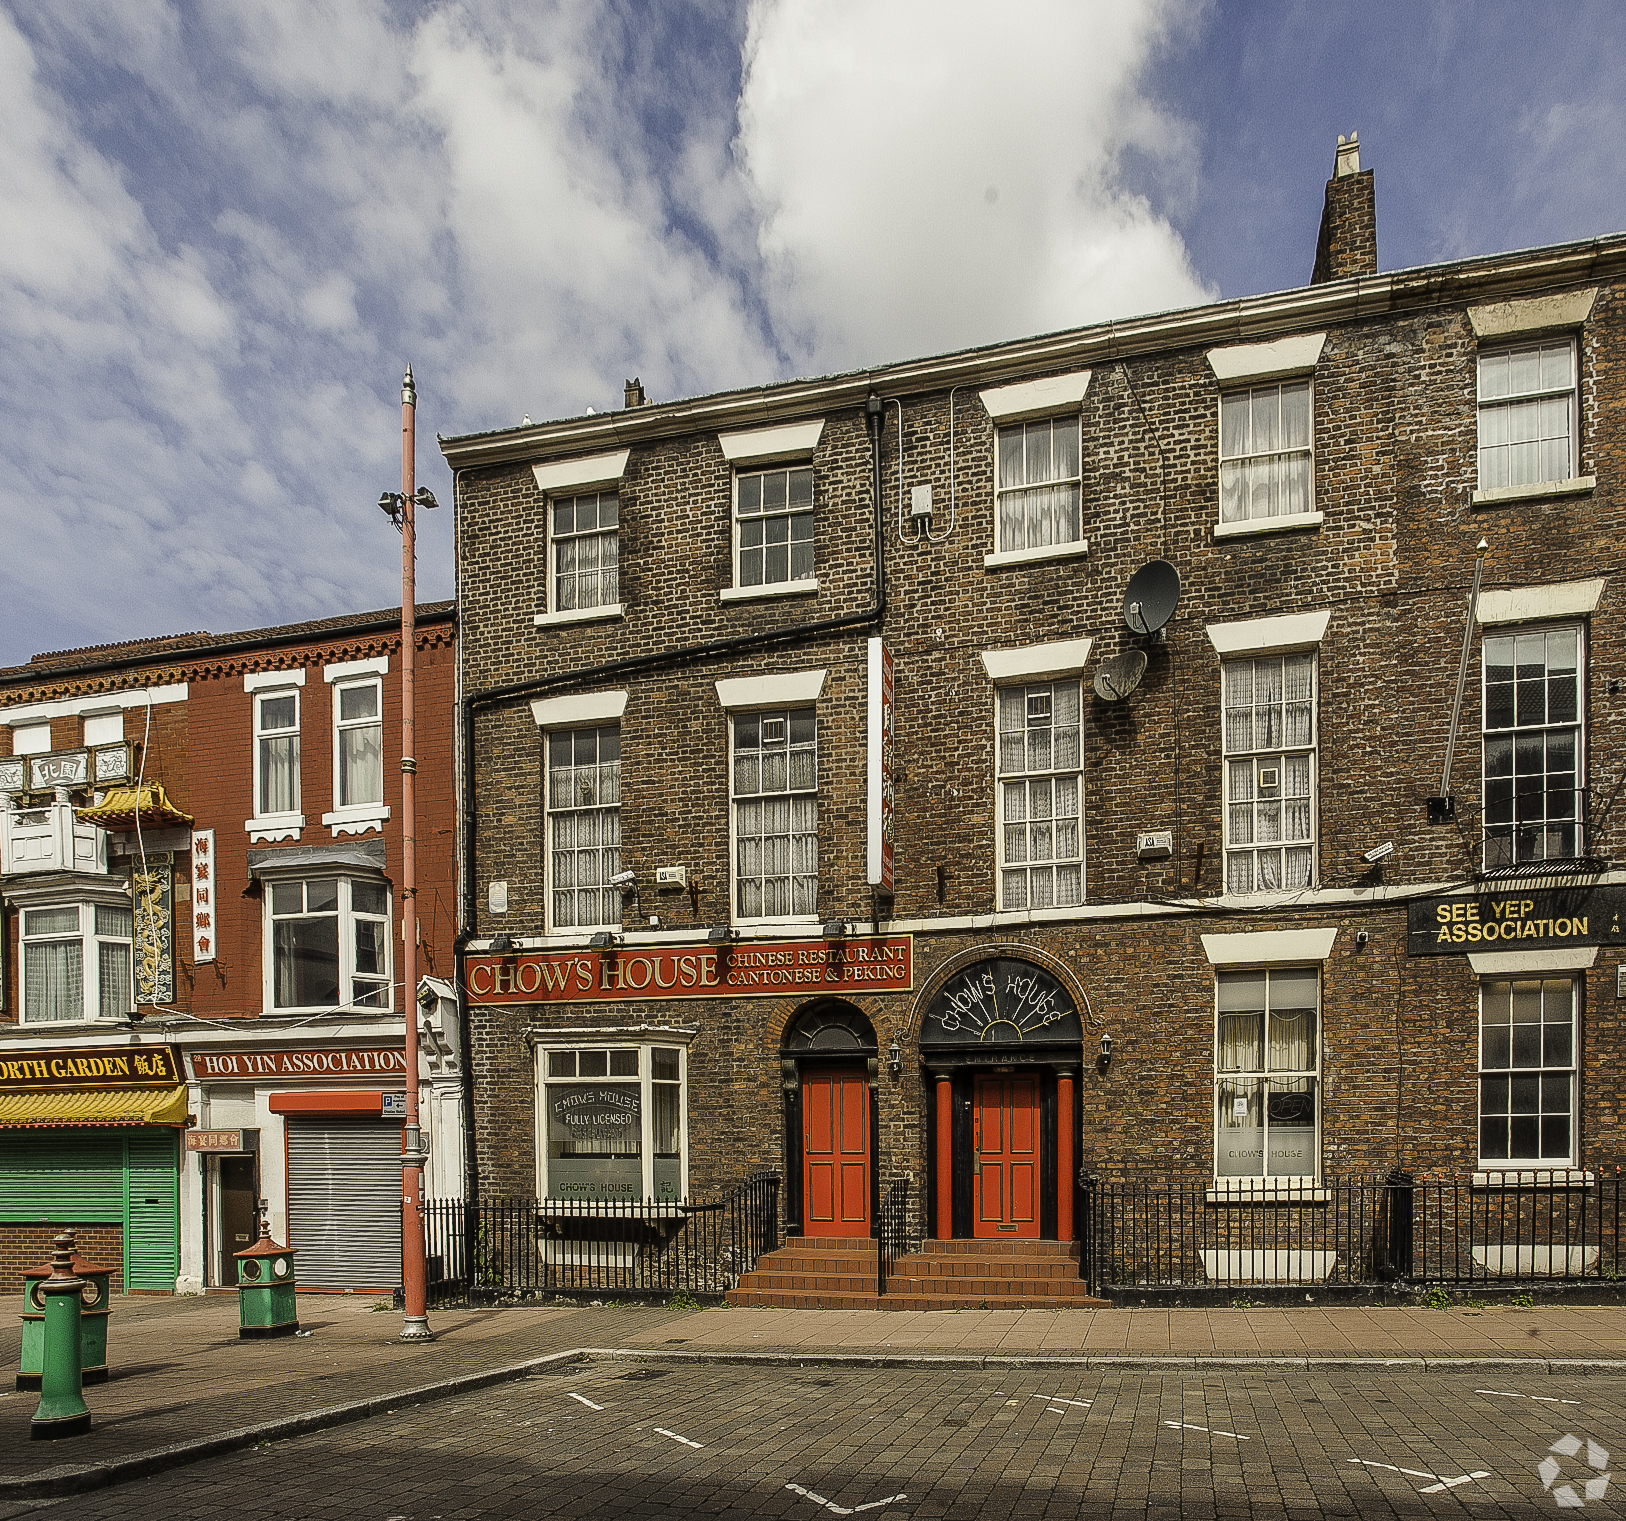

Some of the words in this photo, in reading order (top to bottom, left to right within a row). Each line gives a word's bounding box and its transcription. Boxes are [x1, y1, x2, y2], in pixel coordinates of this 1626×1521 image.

[1437, 903, 1480, 923] SEE
[1491, 900, 1534, 919] YEP
[1437, 917, 1588, 943] ASSOCIATION
[726, 952, 794, 967] CHINESE
[798, 946, 907, 965] RESTAURANT
[469, 957, 594, 995] CHOW'S
[599, 954, 721, 990] HOUSE
[726, 969, 821, 985] CANTONESE
[824, 968, 840, 981] &
[842, 965, 907, 981] PEKING
[1006, 976, 1061, 1026] HOUSE
[51, 1056, 130, 1078] GARDEN
[134, 1053, 167, 1076] 飯店
[204, 1055, 240, 1074] HOI
[241, 1054, 278, 1073] YIN
[281, 1051, 407, 1072] ASSOCIATION
[599, 1090, 640, 1111] HOUSE
[1269, 1100, 1313, 1113] OPEN
[565, 1113, 590, 1124] FULLY
[593, 1113, 632, 1124] LICENSED
[1228, 1150, 1264, 1158] CHOW'S
[1271, 1150, 1303, 1158] HOUSE
[559, 1183, 596, 1192] CHOW'S
[600, 1183, 633, 1193] HOUSE
